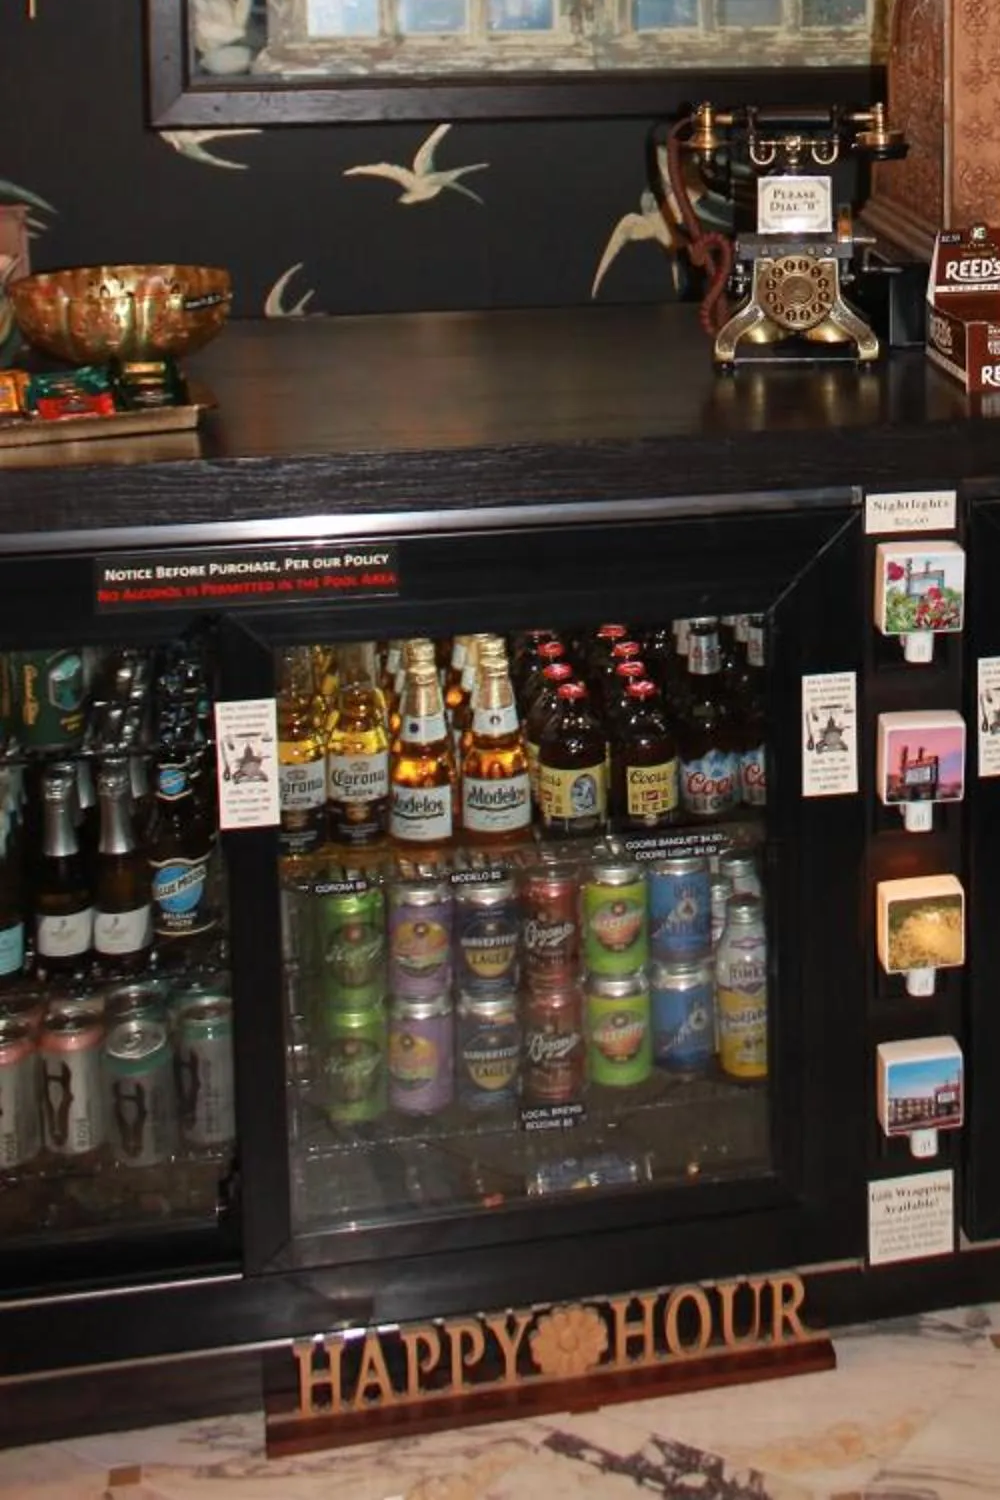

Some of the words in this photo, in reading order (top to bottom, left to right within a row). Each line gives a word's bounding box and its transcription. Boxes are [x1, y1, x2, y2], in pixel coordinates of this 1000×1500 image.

[104, 569, 152, 581] NOTICE
[156, 565, 205, 578] BEFORE
[209, 560, 281, 576] PURCHASE,
[285, 558, 309, 570] PER
[312, 557, 341, 569] OUR
[345, 553, 390, 567] POLICY
[332, 767, 386, 787] Corona
[451, 872, 489, 883] MODELO
[315, 883, 354, 893] CORONA
[292, 1308, 535, 1418] HAPPY
[610, 1275, 822, 1367] HOUR
